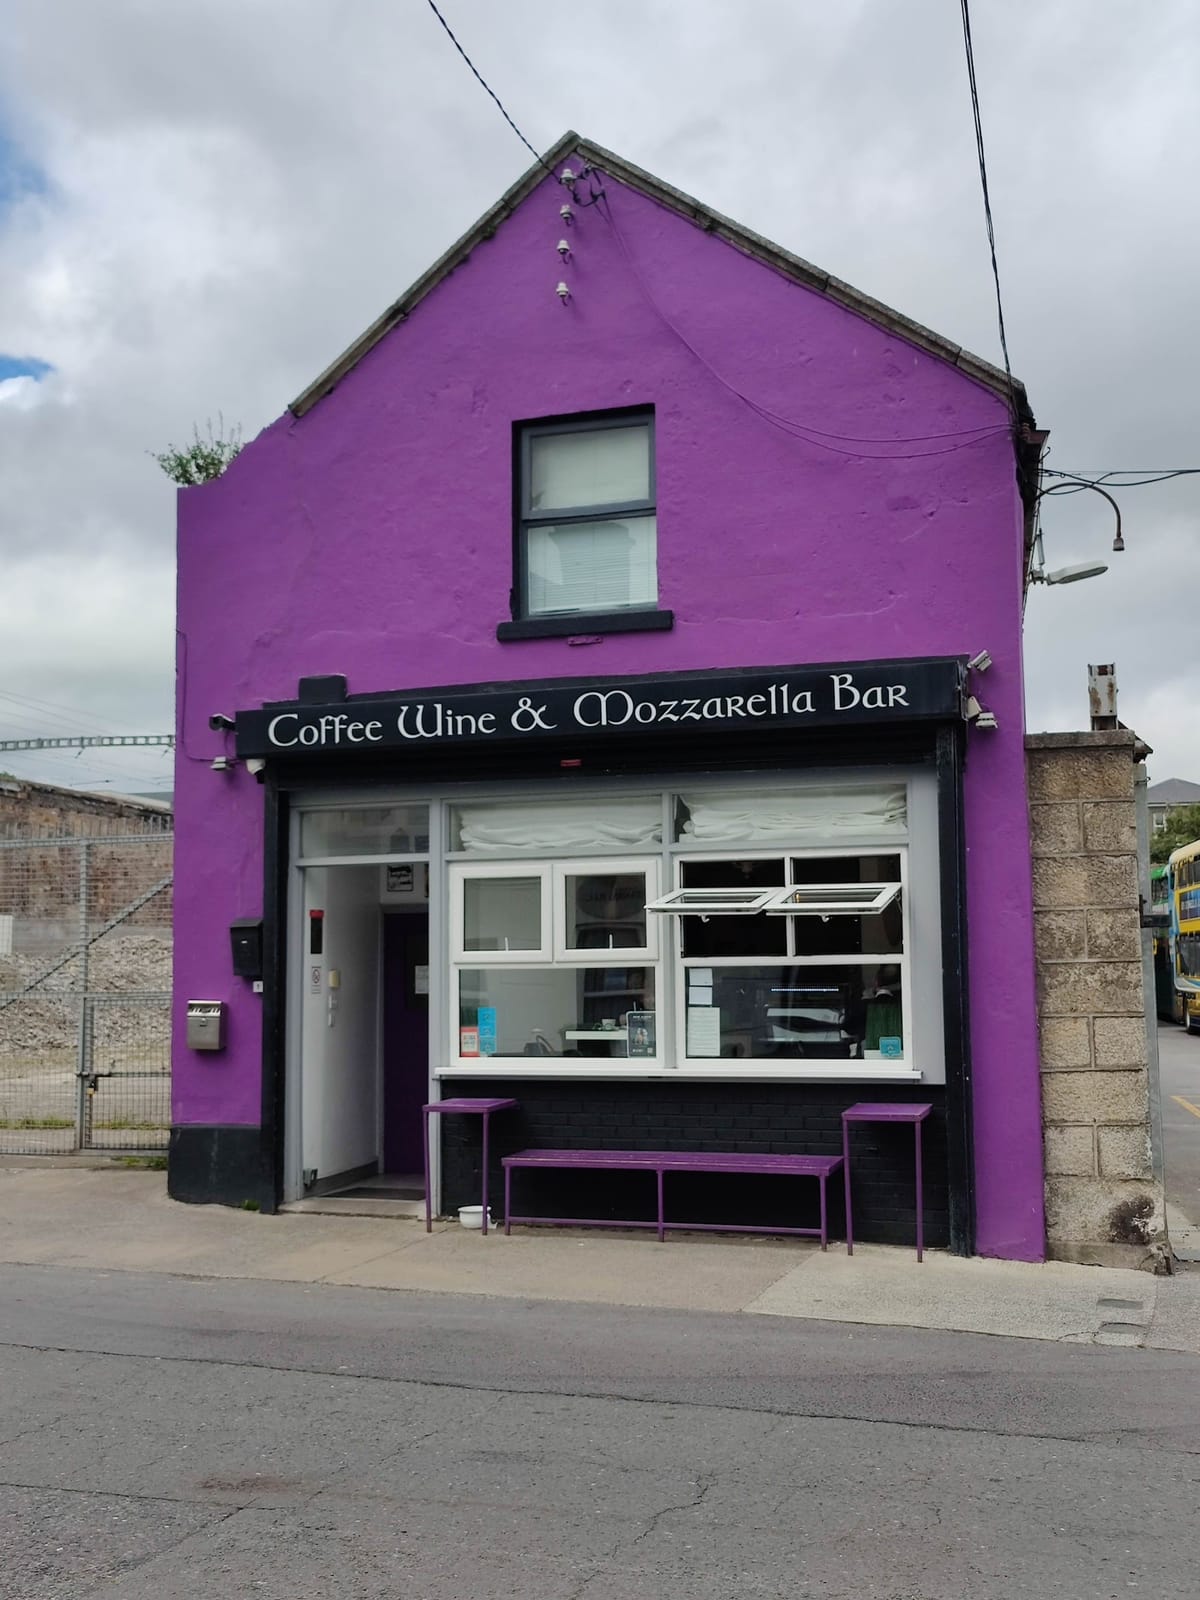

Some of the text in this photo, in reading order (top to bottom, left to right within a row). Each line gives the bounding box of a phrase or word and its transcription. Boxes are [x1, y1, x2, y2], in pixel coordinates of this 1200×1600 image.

[268, 673, 910, 747] Coffee Wine & Mozzarella Bar
